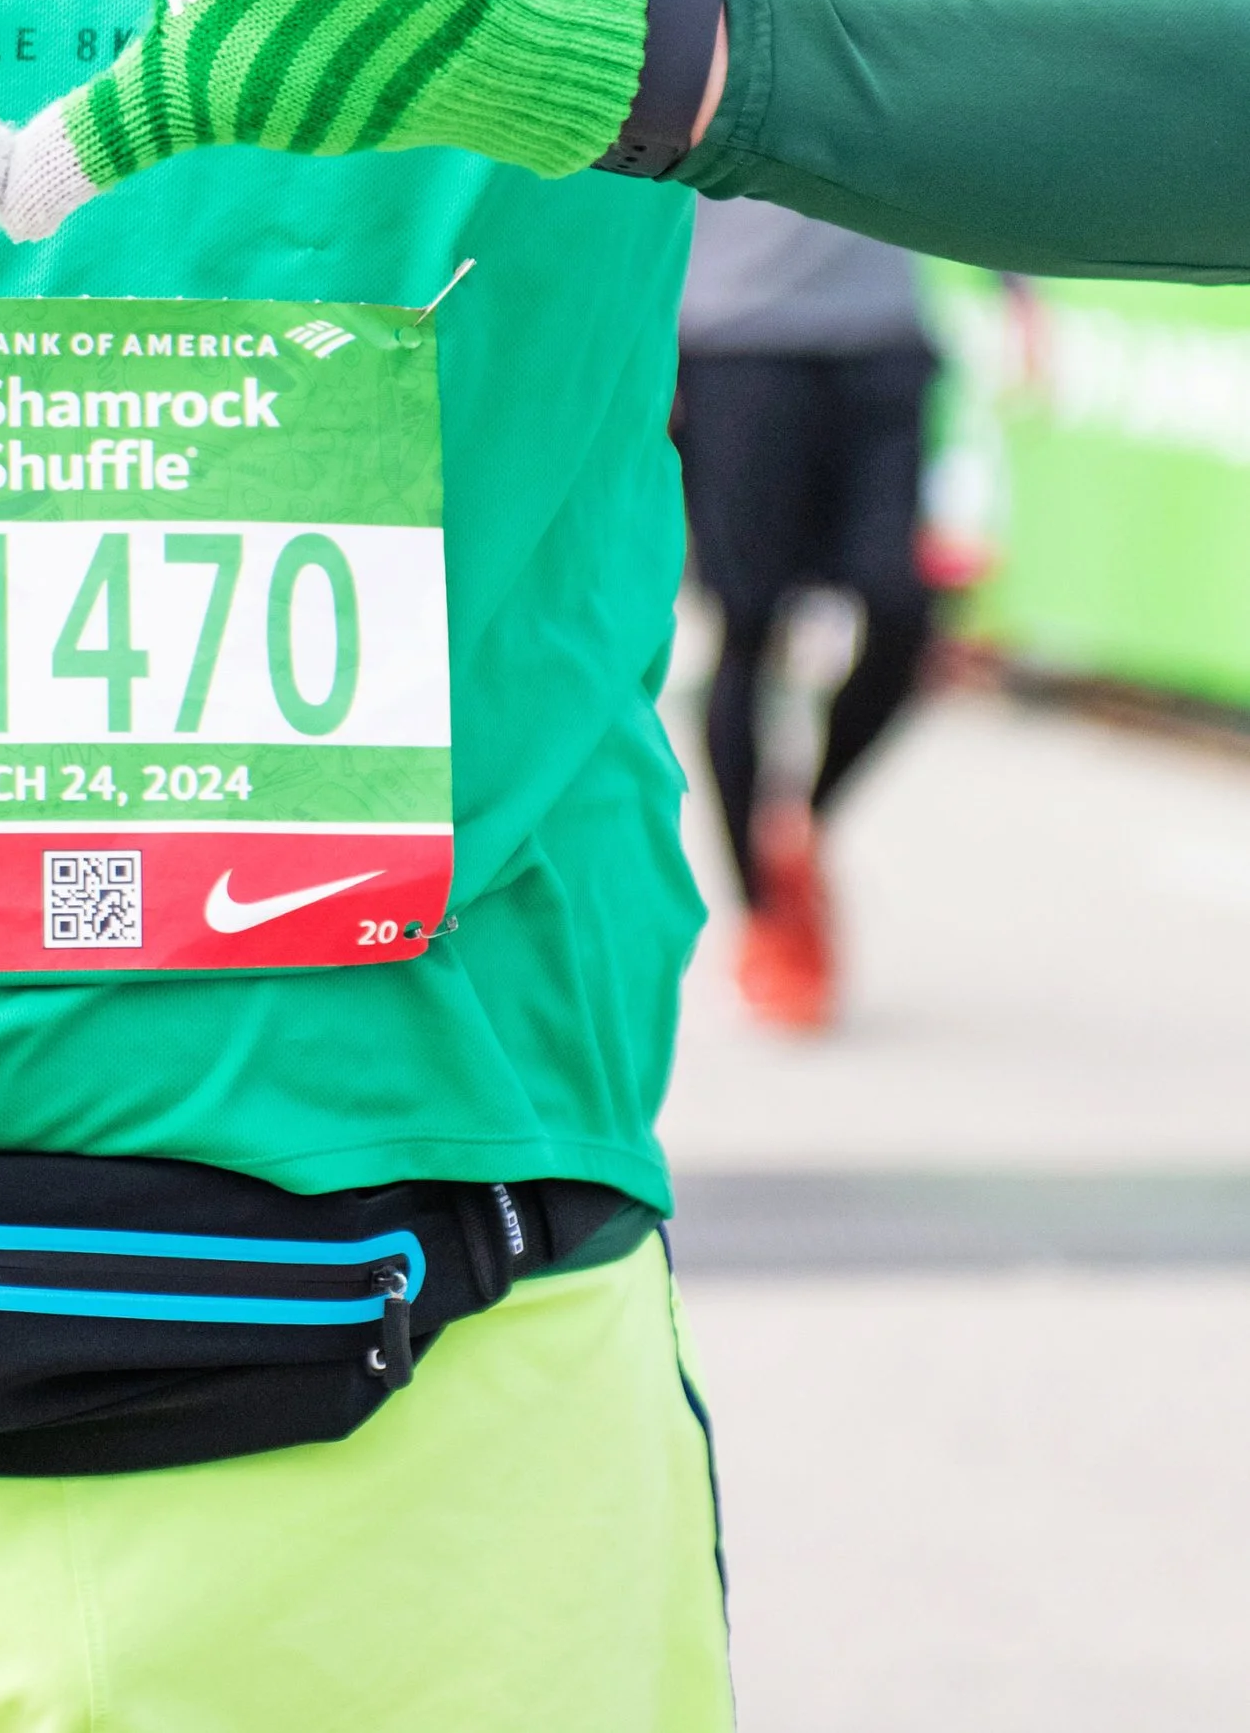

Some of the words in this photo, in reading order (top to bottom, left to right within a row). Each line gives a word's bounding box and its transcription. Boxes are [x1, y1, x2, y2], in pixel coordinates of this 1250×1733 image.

[70, 332, 114, 356] OF
[123, 333, 278, 357] AMERICA
[61, 766, 127, 806] 24,
[142, 765, 252, 801] 2024
[357, 920, 398, 945] 20
